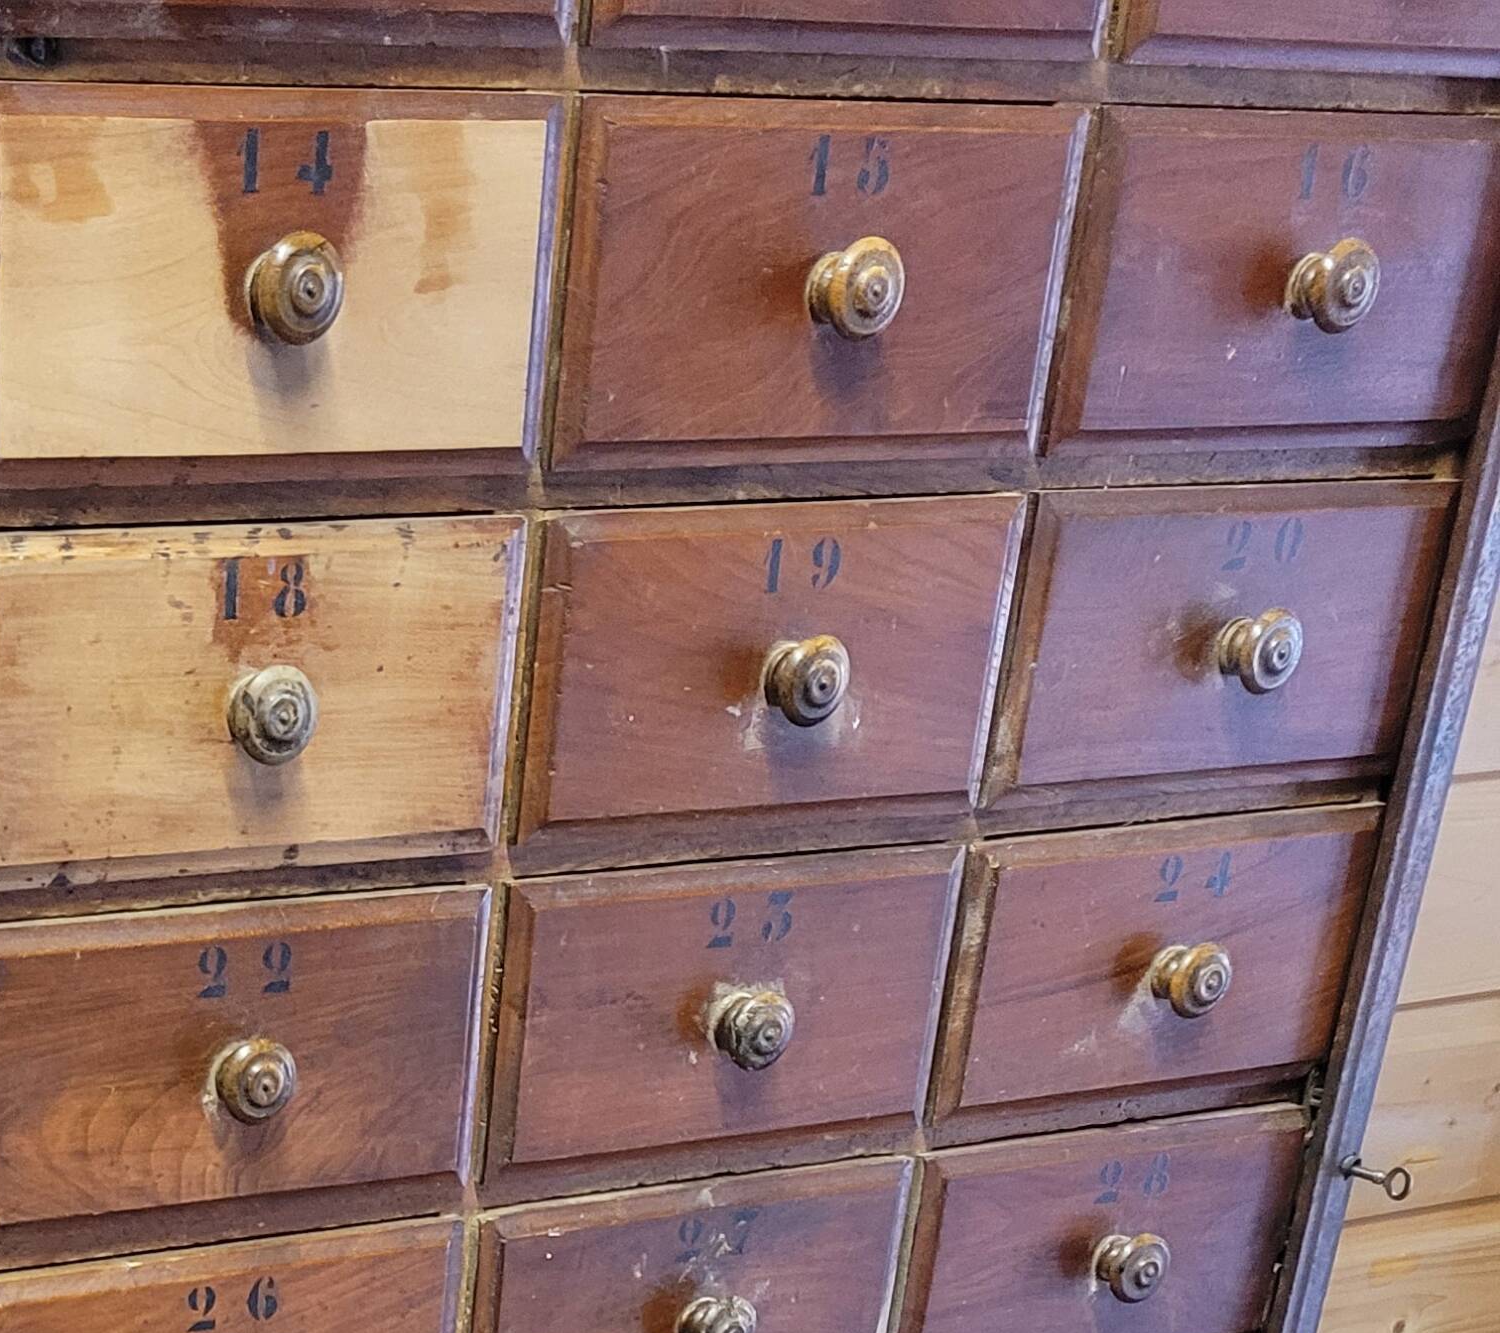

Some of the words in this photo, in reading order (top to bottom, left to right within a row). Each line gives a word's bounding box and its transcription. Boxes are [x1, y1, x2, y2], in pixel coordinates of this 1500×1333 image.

[237, 127, 334, 196] 14
[809, 134, 891, 197] 15
[1300, 142, 1370, 202] 16
[764, 537, 841, 595] 19
[1221, 517, 1303, 571] 20
[223, 557, 307, 620] 18
[1154, 851, 1233, 903] 24
[196, 942, 292, 999] 22
[186, 1276, 278, 1333] 26
